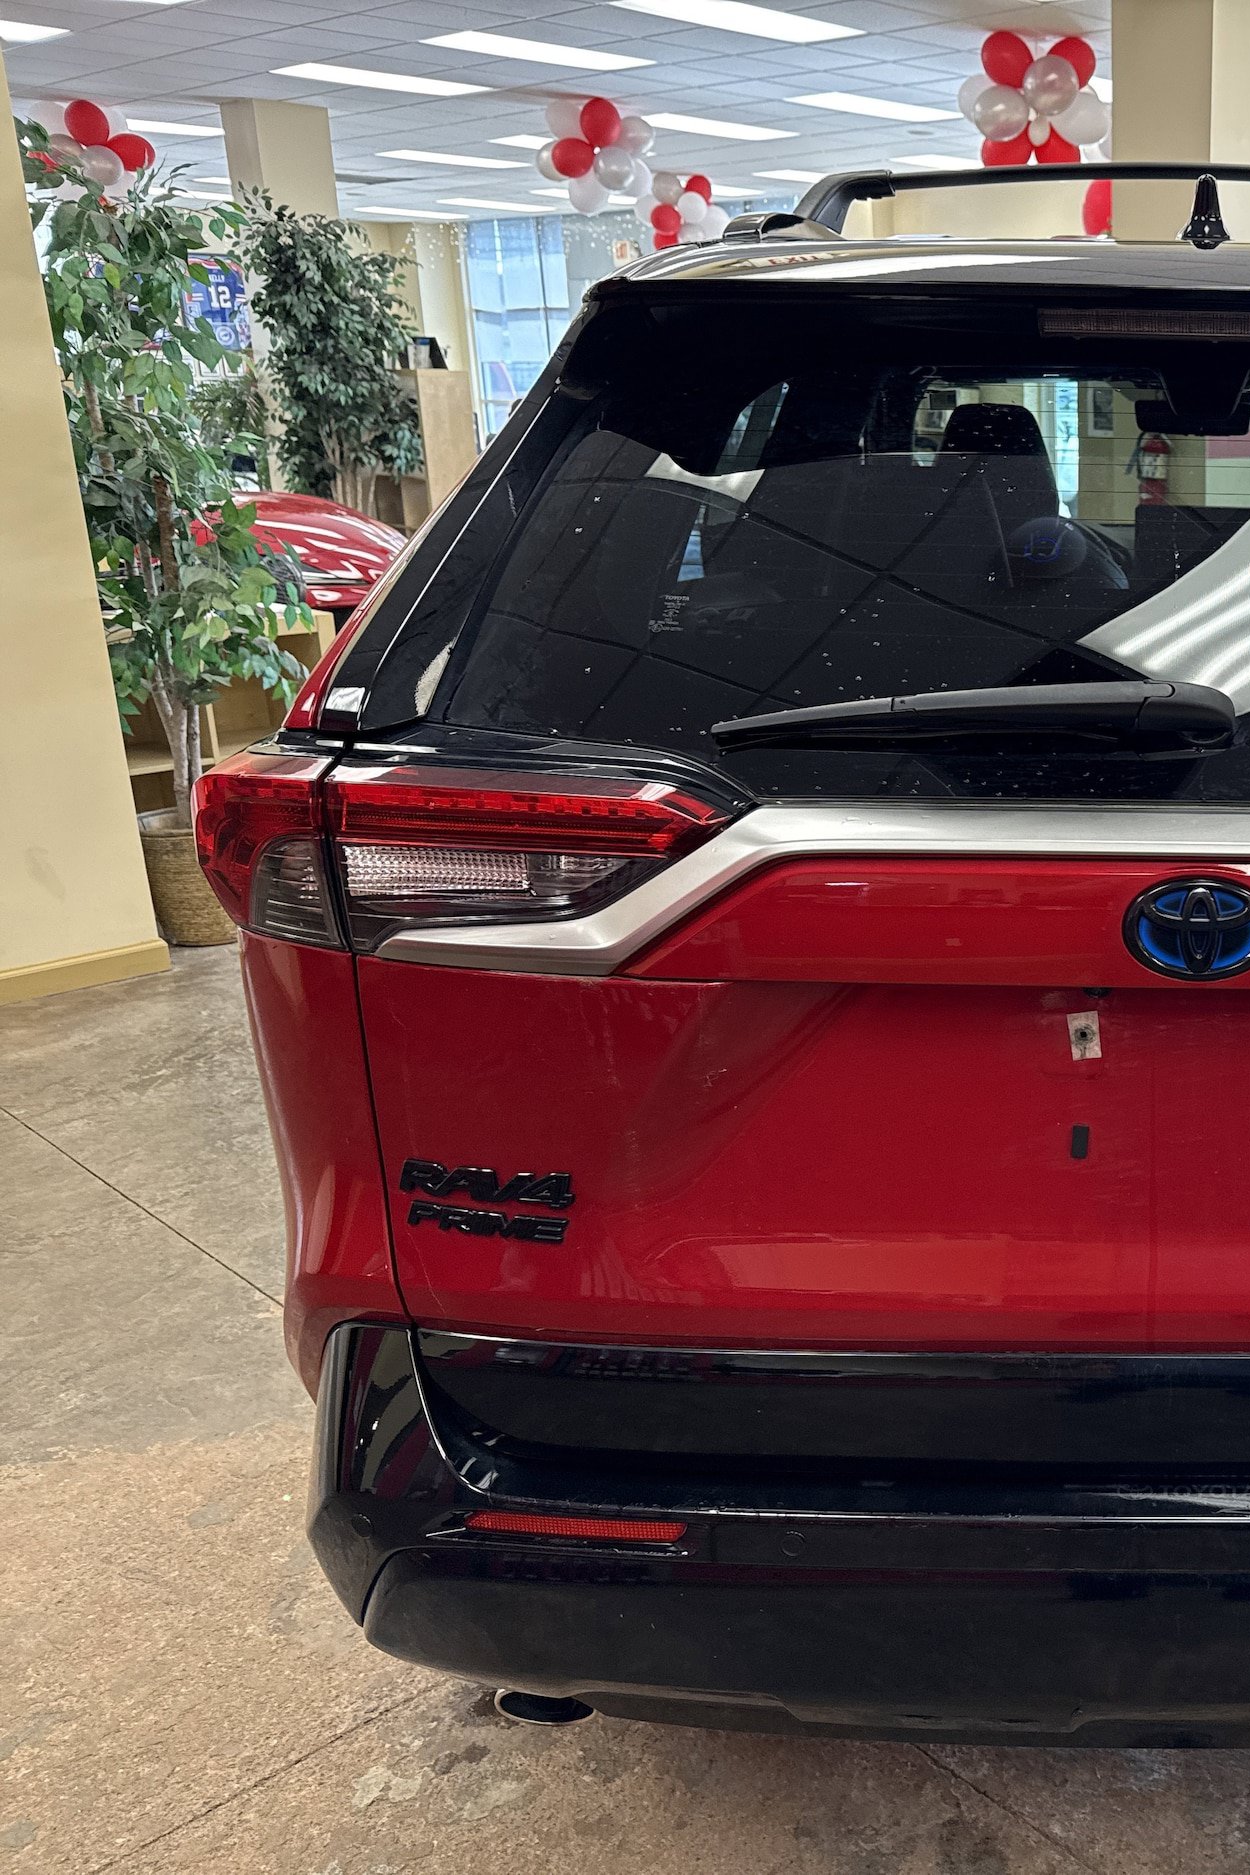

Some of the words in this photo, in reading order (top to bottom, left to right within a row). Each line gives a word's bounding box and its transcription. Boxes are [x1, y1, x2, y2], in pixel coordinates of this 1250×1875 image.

[208, 284, 232, 309] 12
[400, 1157, 575, 1209] RAV4
[407, 1200, 570, 1244] PRIME
